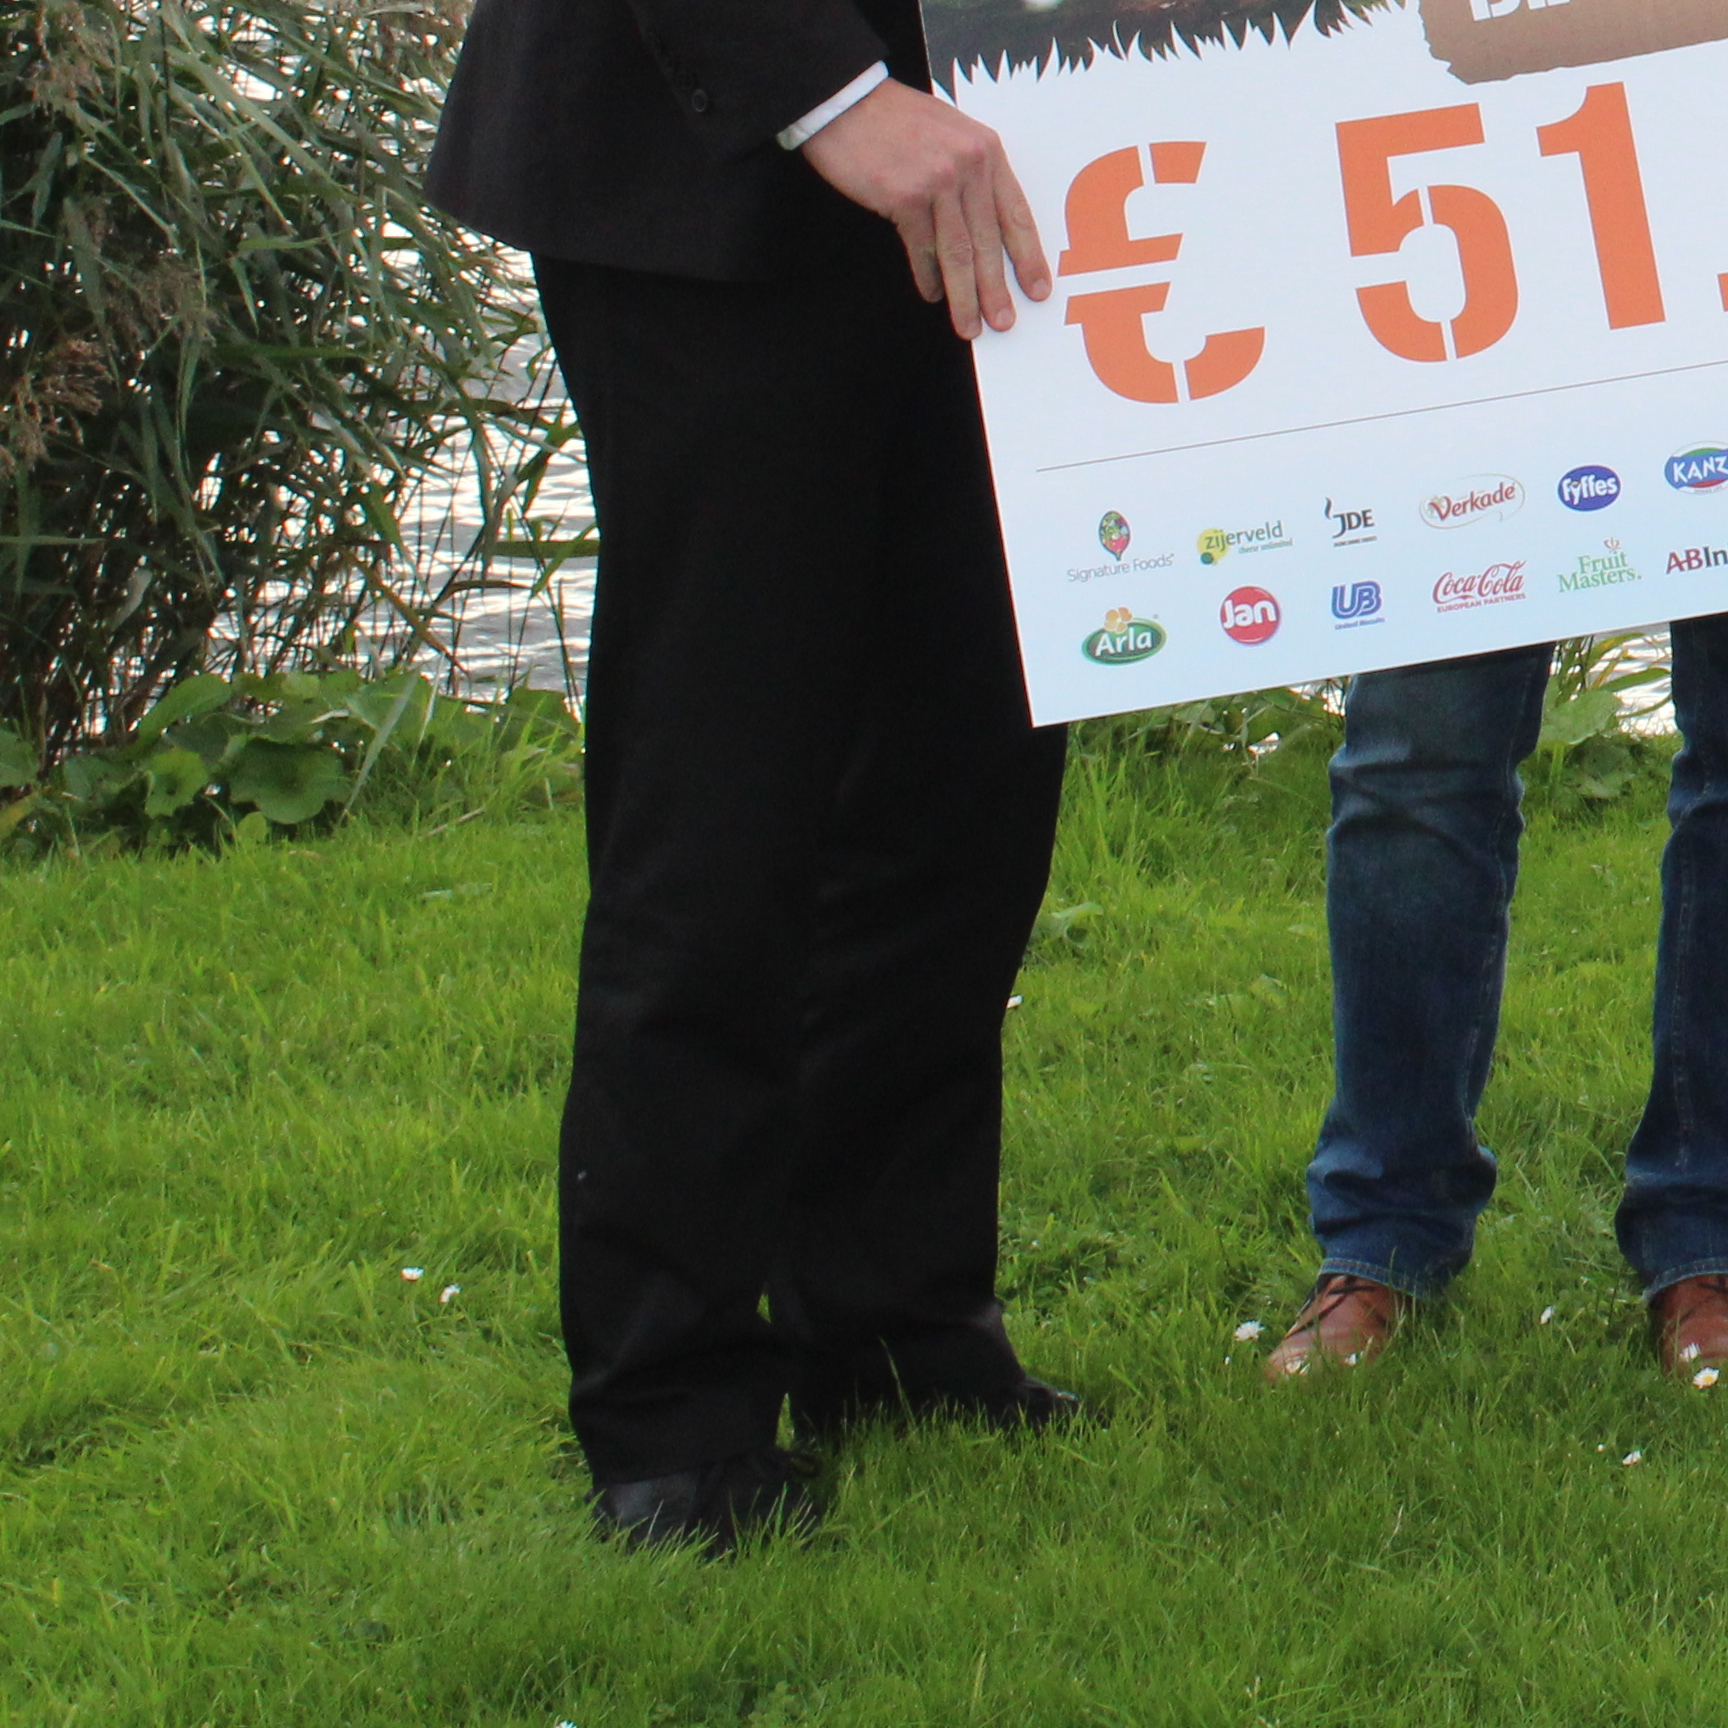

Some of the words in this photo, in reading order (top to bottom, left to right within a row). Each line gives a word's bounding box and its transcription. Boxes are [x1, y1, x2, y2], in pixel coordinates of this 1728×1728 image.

[1057, 140, 1266, 405] €
[1427, 480, 1516, 522] Verkade
[1204, 519, 1285, 552] zijerveld
[1331, 507, 1376, 539] JDE
[1066, 561, 1131, 583] Signature
[1132, 553, 1174, 572] Foods
[1577, 549, 1630, 573] Fruit
[1219, 595, 1278, 630] Jan
[1330, 579, 1383, 621] UB
[1436, 598, 1483, 614] EUROPEAN
[1483, 592, 1528, 607] PARTNERS
[1093, 626, 1155, 658] Arla
